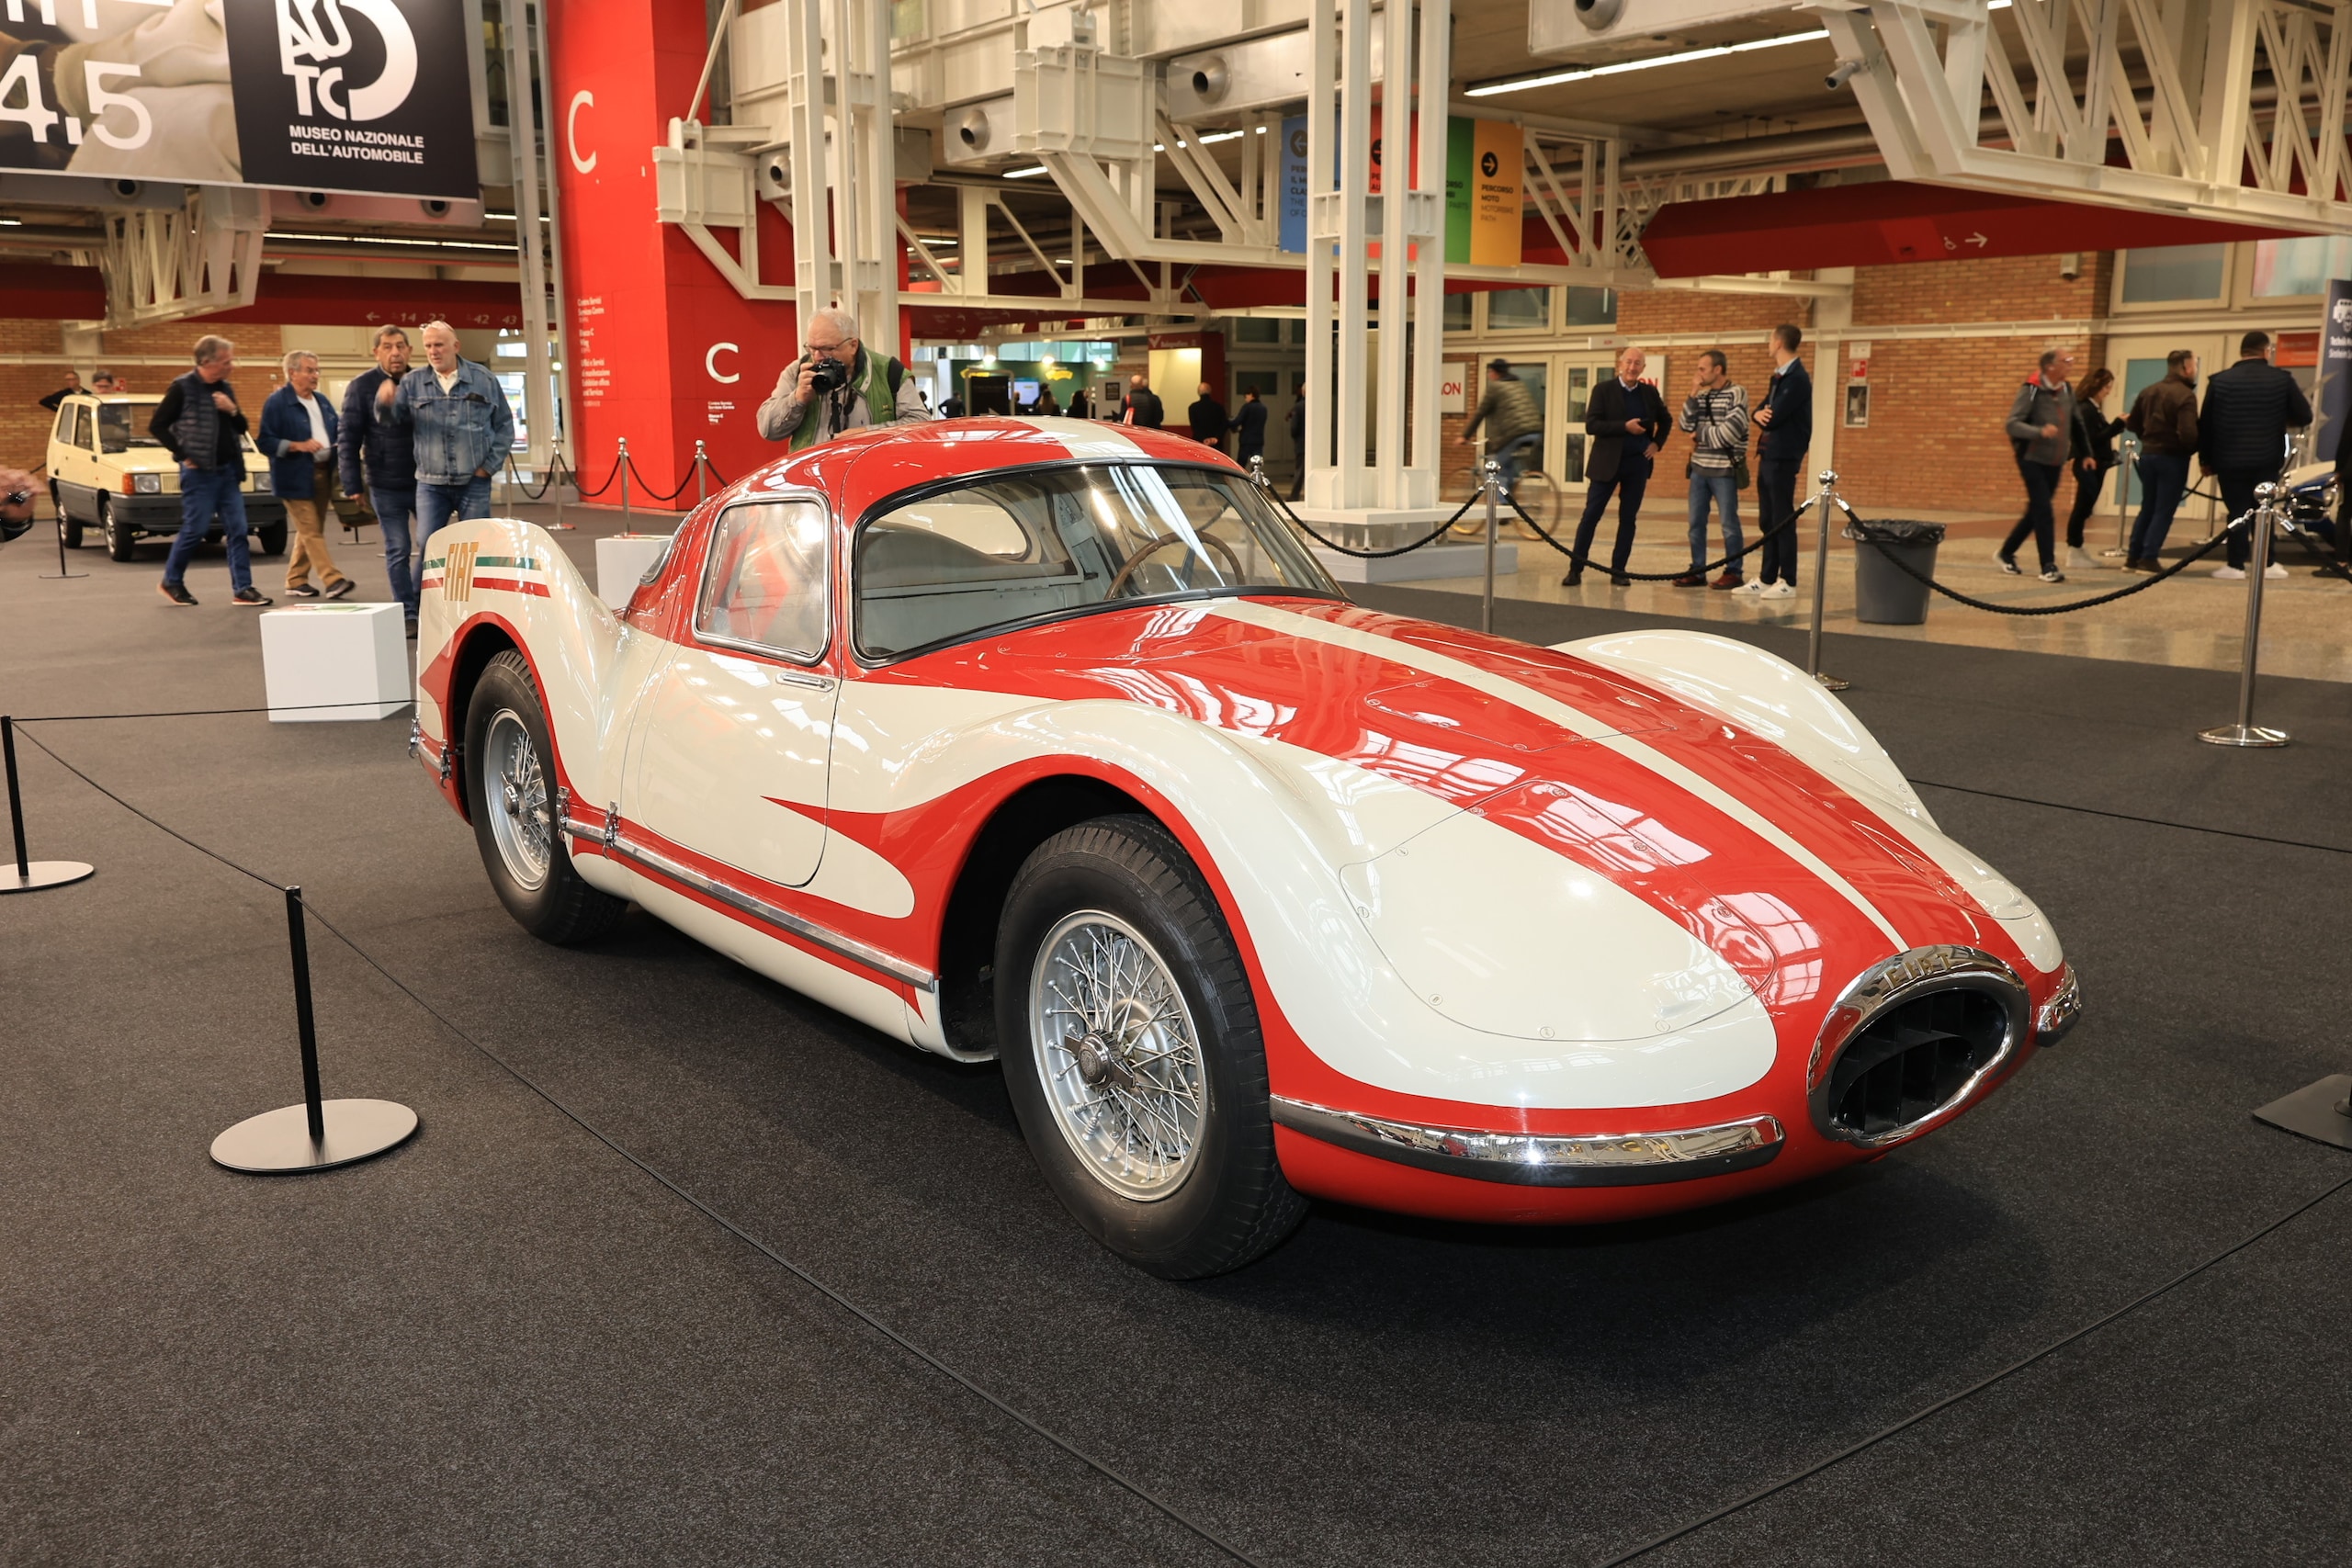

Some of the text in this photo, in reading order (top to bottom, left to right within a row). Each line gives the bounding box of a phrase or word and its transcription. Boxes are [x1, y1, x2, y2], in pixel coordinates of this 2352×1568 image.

[289, 125, 424, 148] MUSEO NAZIONALE
[568, 90, 597, 174] C
[291, 141, 424, 164] DELL'AUTOMOBILE
[1481, 184, 1514, 194] PERCORSO
[1481, 195, 1499, 203] MOTO
[706, 342, 741, 384] C
[444, 542, 479, 602] FIAT
[1883, 953, 1951, 989] FIAT
